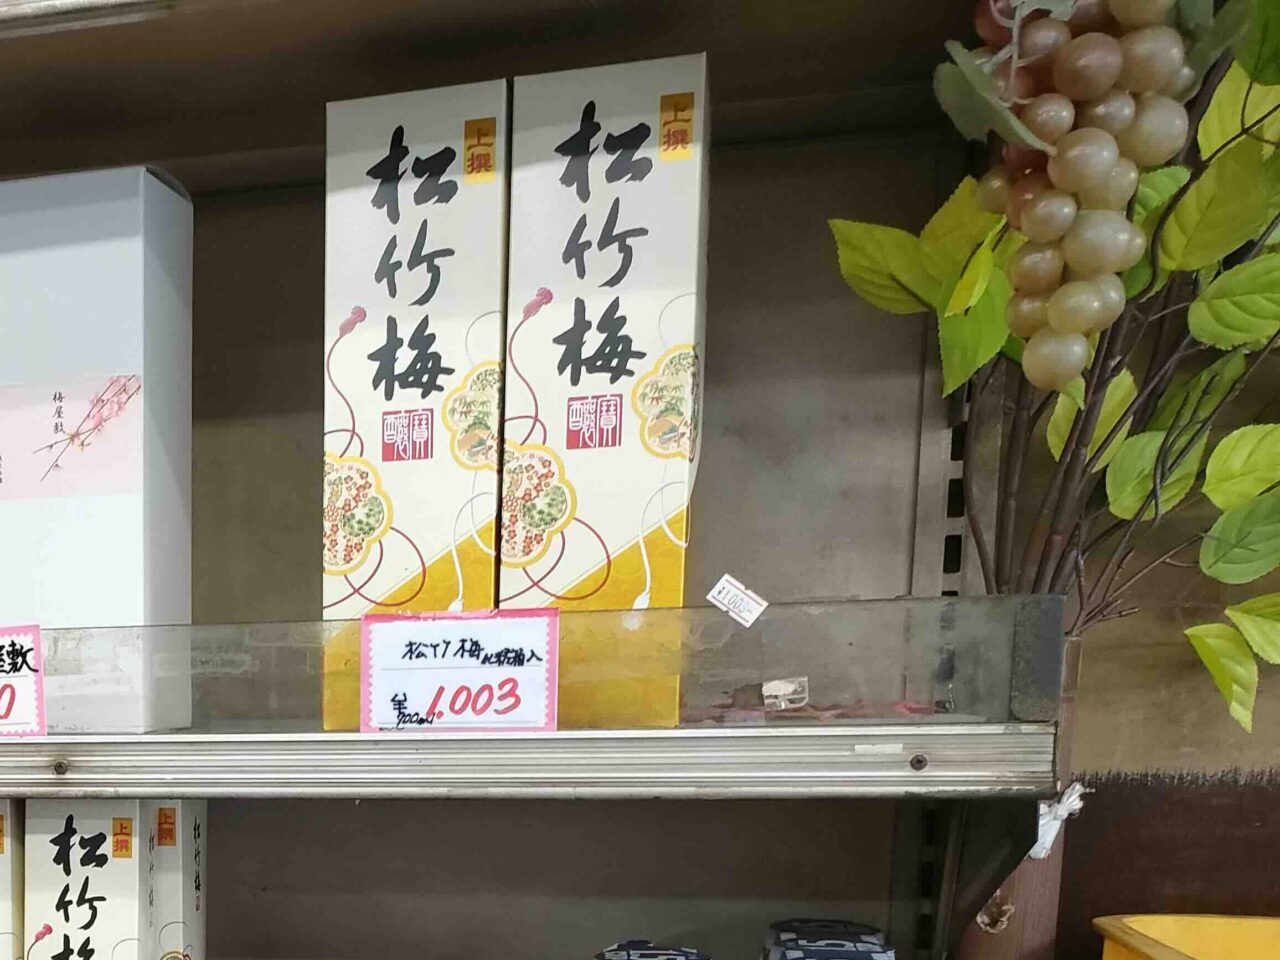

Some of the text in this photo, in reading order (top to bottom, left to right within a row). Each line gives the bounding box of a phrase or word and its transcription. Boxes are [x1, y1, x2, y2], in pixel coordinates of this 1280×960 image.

[466, 128, 494, 174] 上撰
[662, 102, 692, 152] 上撰
[366, 124, 459, 401] 松竹梅
[552, 101, 653, 387] 松竹梅
[113, 821, 131, 853] 上撰
